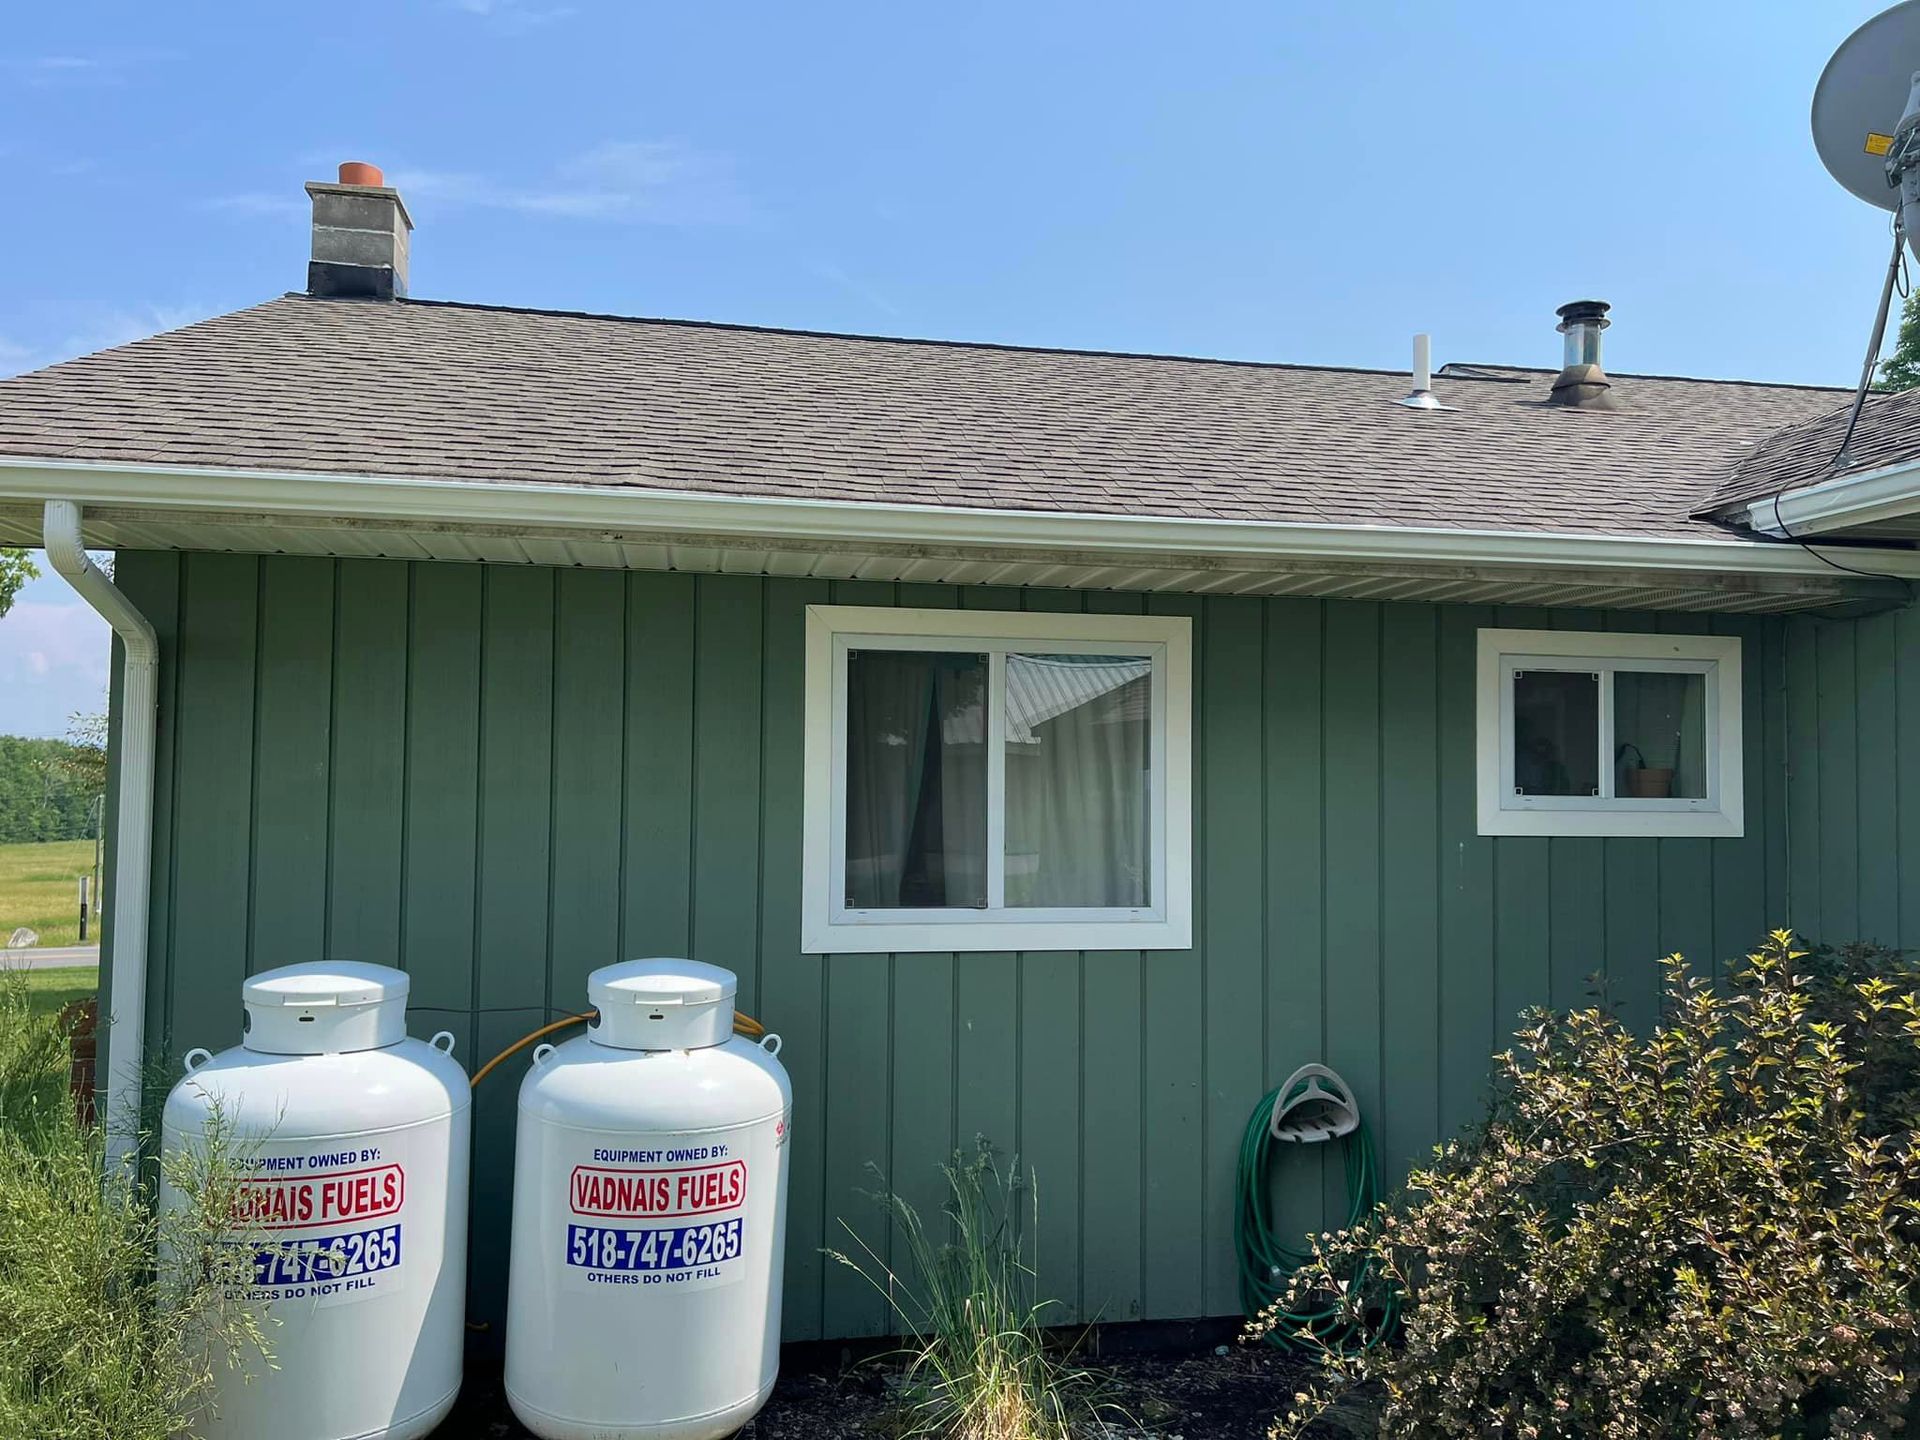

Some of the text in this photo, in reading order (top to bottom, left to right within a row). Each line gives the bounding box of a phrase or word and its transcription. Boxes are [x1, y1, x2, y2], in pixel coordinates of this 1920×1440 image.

[308, 1151, 357, 1169] OWNED
[361, 1147, 381, 1162] BY:
[594, 1145, 728, 1163] EQUIPMENT OWNED BY:
[322, 1173, 396, 1219] FUELS
[577, 1168, 740, 1212] VADNAIS FUELS
[572, 1220, 739, 1269] 518-747-6265
[587, 1266, 721, 1285] OTHERS DO NOT FILL
[285, 1288, 306, 1299] DO
[310, 1283, 342, 1297] NOT
[346, 1276, 376, 1291] FILL
